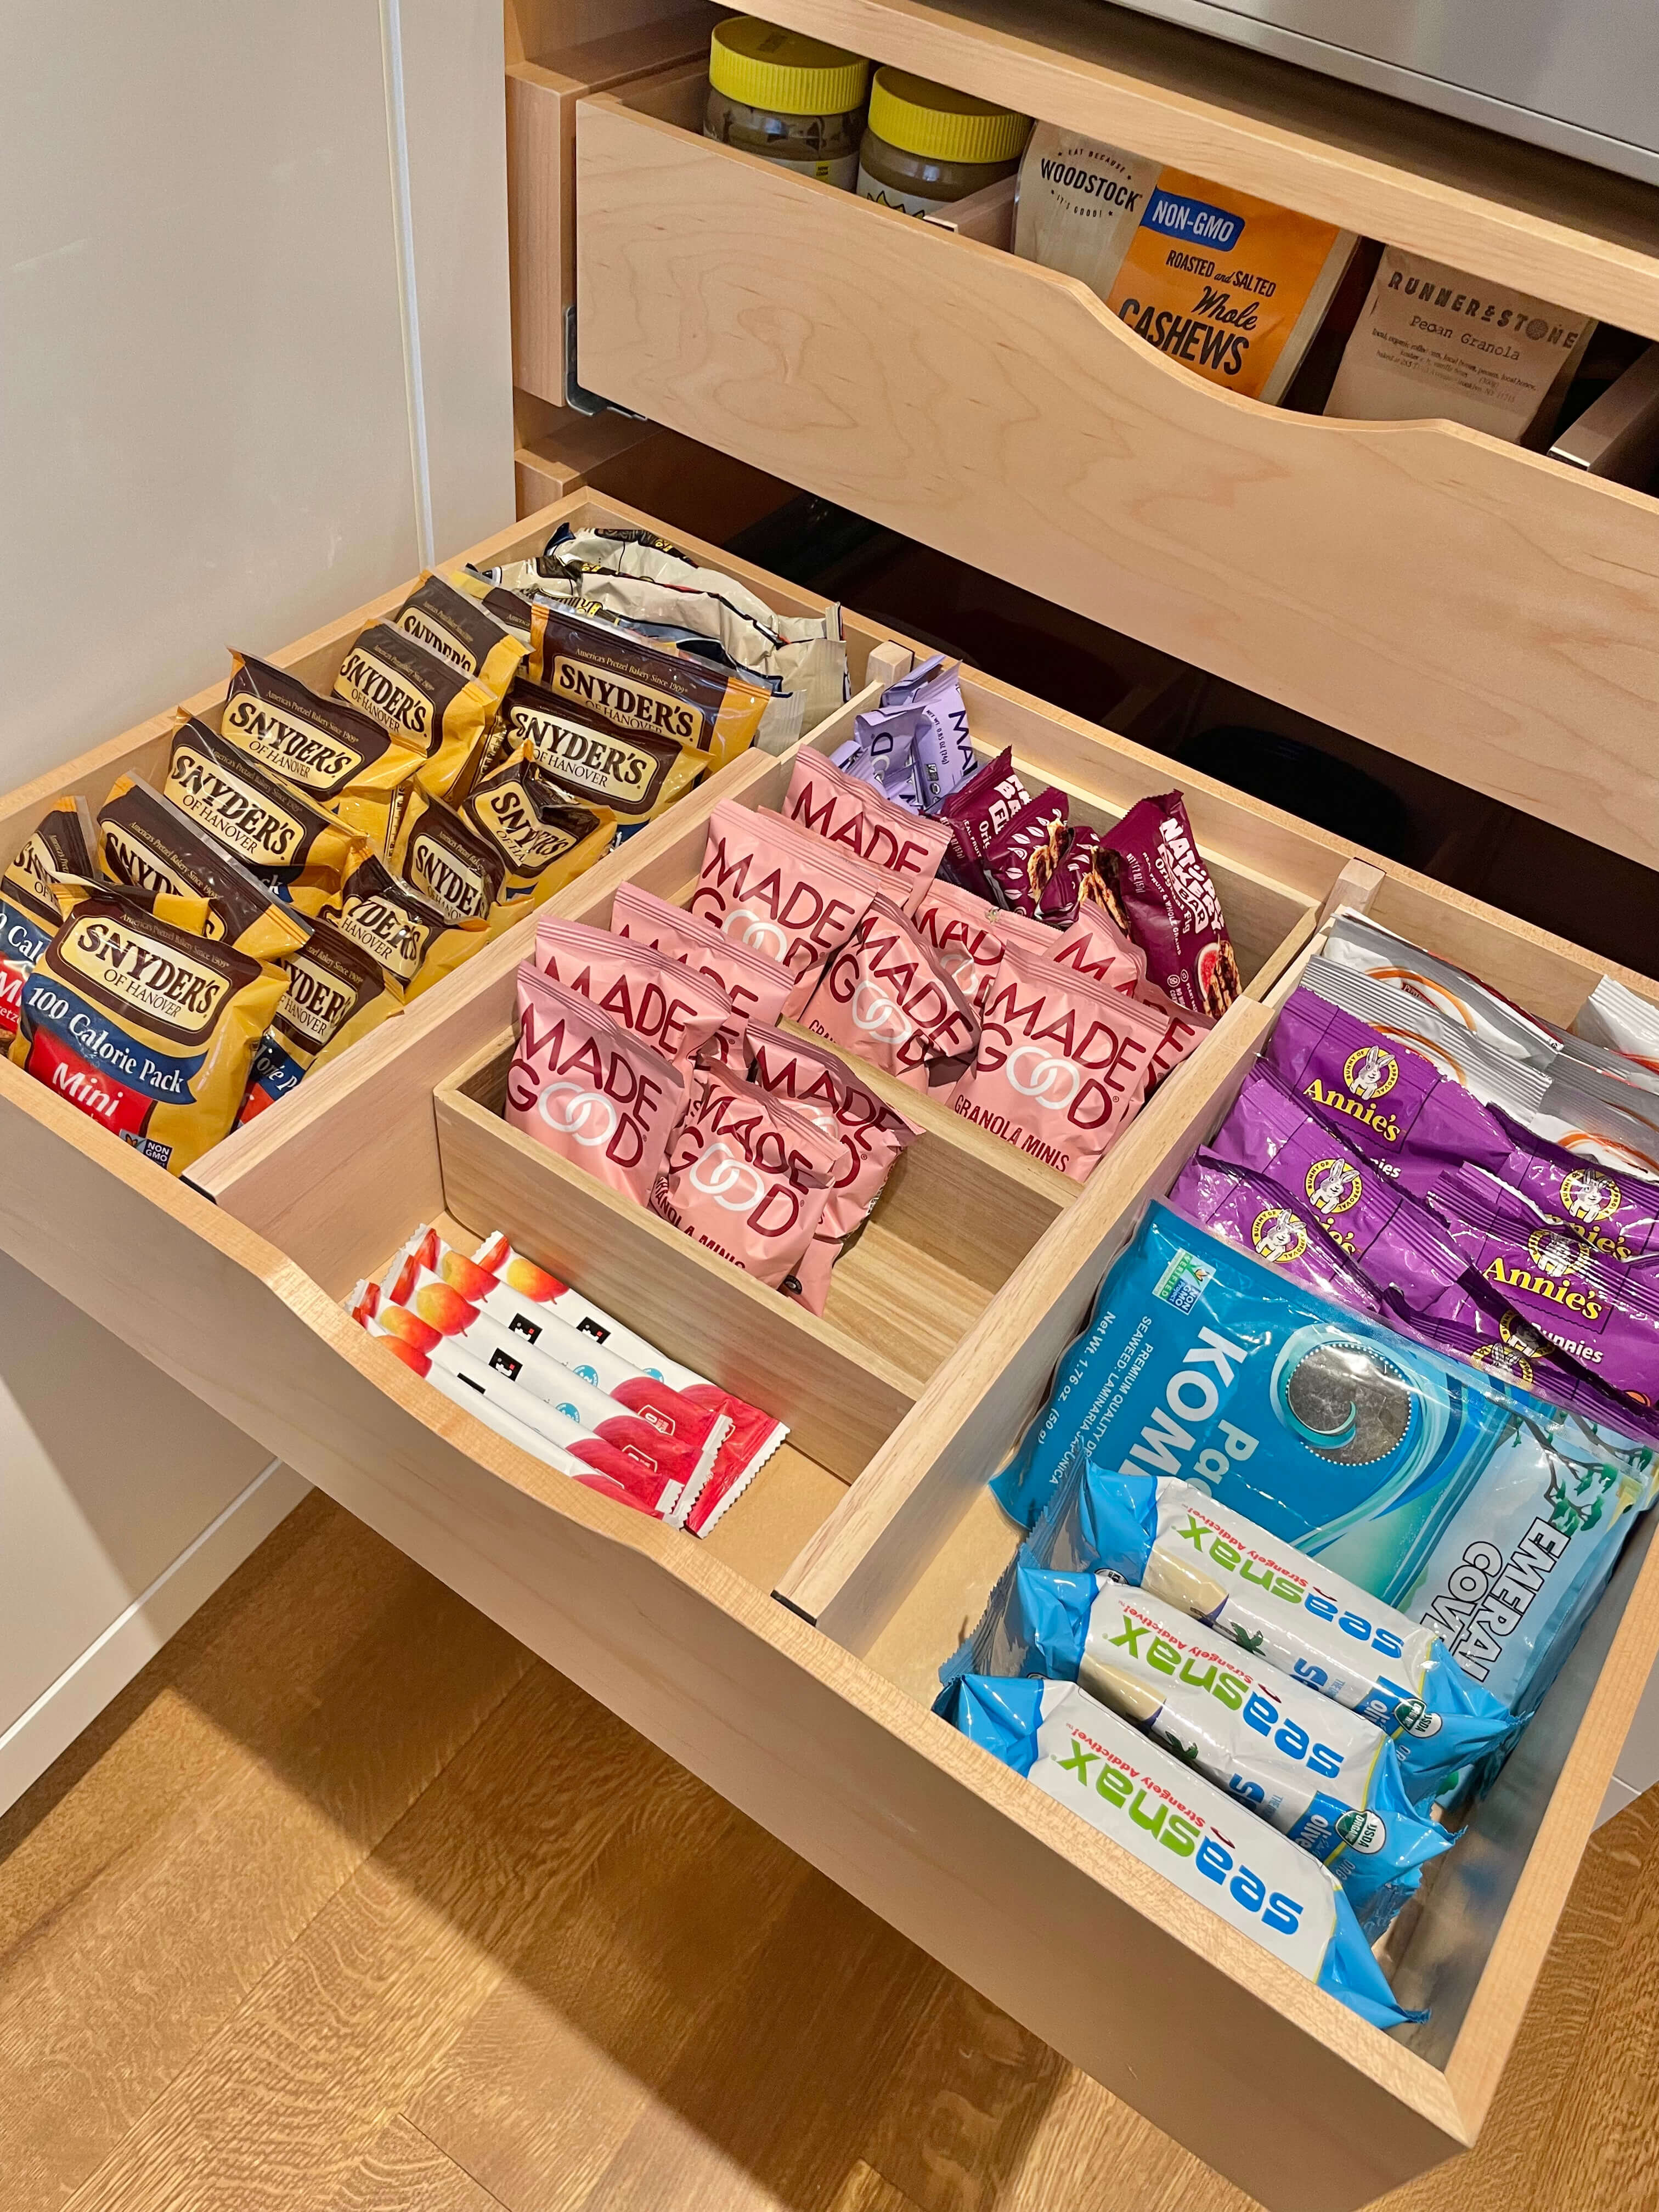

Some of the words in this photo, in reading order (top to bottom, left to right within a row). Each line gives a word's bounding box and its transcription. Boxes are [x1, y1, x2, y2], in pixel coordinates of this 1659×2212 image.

[1041, 157, 1139, 212] WOODSTOCK
[1074, 206, 1102, 218] GOOD!
[1152, 200, 1234, 242] NON-GMO
[1165, 250, 1215, 278] ROASTED
[1214, 272, 1234, 284] and
[1232, 270, 1277, 298] SALTED
[1191, 285, 1260, 331] Whole
[1119, 298, 1250, 376] CASHEWS
[1460, 332, 1520, 361] Granola
[340, 654, 426, 733] SNYDER'S
[606, 657, 629, 671] Pretzel
[629, 666, 651, 681] Bakery
[651, 674, 669, 687] Since
[351, 688, 362, 703] OF
[363, 696, 400, 733] HANOVER
[560, 663, 693, 737] SNYDER'S
[229, 702, 353, 775] SNYDER'S
[249, 740, 269, 754] OF
[266, 749, 311, 779] HANOVER
[515, 712, 647, 785] SNYDER'S
[533, 748, 548, 761] OF
[548, 754, 608, 788] HANOVER
[171, 755, 296, 855] SNYDER'S
[182, 794, 202, 811] OF
[199, 804, 258, 854] HANOVER
[791, 780, 929, 873] MADE
[702, 837, 855, 949] MADE
[1165, 900, 1178, 927] WHOLE
[1178, 888, 1205, 923] BAR
[341, 917, 393, 960] HANOVER
[1182, 910, 1193, 934] Fig
[77, 923, 221, 1014] SNYDER'S
[855, 916, 974, 1046] MADE
[103, 969, 128, 987] OF
[126, 980, 182, 1018] HANOVER
[284, 997, 328, 1036] HANOVER
[544, 955, 698, 1055] MADE
[829, 952, 925, 1066] GOOD
[28, 987, 69, 1020] 100
[69, 1013, 137, 1074] Calorie
[139, 1058, 184, 1093] Pack
[984, 982, 1147, 1092] MADE
[52, 1062, 123, 1117] Mini
[521, 1002, 663, 1132] MADE
[976, 1022, 1113, 1130] GOOD
[1345, 1053, 1358, 1081] BUNNY
[1375, 1063, 1397, 1095] APPROVAL
[506, 1058, 645, 1168] GOOD
[954, 1094, 1022, 1147] GRANOLA
[1020, 1134, 1070, 1173] MINIS
[1303, 1077, 1402, 1144] Annie's
[145, 1149, 168, 1163] GMO
[147, 1142, 170, 1155] NON
[697, 1083, 814, 1195] MADE
[668, 1126, 800, 1238] GOOD
[1307, 1163, 1320, 1189] BUNNY
[1338, 1180, 1361, 1211] APPROVAL
[1254, 1213, 1267, 1238] BUNNY
[1161, 1253, 1193, 1298] VERIFIED
[1175, 1285, 1192, 1307] GMO
[1482, 1256, 1603, 1321] Annie's
[1096, 1311, 1116, 1335] Net
[1181, 1288, 1198, 1312] NON
[1084, 1335, 1103, 1355] Wt.
[1114, 1316, 1152, 1372] SEAWEED:
[1069, 1358, 1088, 1385] 1.76
[1119, 1342, 1154, 1395] PREMIUM
[1057, 1385, 1071, 1402] oz.
[1079, 1372, 1120, 1431] LAMINARIA
[1092, 1393, 1124, 1442] QUALITY
[1038, 1429, 1047, 1444] g)
[1045, 1407, 1060, 1430] (50
[1187, 1507, 1246, 1551] Addictive!
[1246, 1550, 1308, 1588] Strangely
[1123, 1605, 1188, 1650] Addictive!
[1188, 1646, 1254, 1684] Strangely
[1415, 1714, 1432, 1733] USDA
[1071, 1728, 1141, 1778] Addictive!
[1141, 1777, 1206, 1828] Strangely
[1295, 1814, 1333, 1849] olive
[1358, 1824, 1377, 1848] USDA
